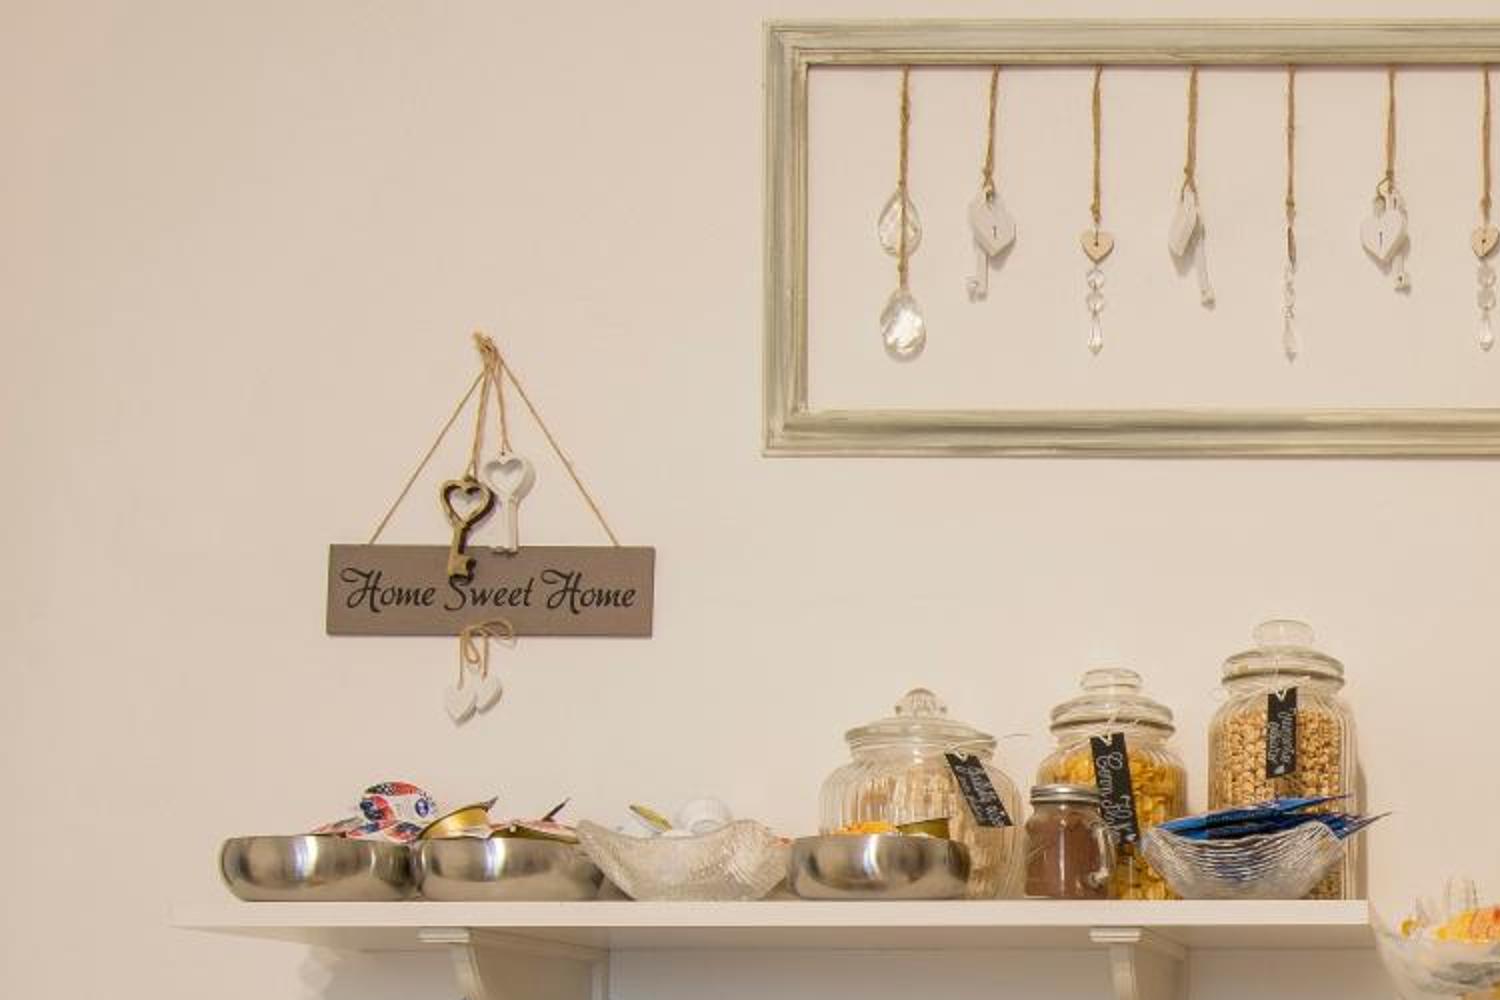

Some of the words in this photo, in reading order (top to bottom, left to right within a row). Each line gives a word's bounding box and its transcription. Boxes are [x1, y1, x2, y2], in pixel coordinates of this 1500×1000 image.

[340, 567, 436, 613] Home
[444, 576, 535, 612] Sweet
[540, 568, 636, 614] Home
